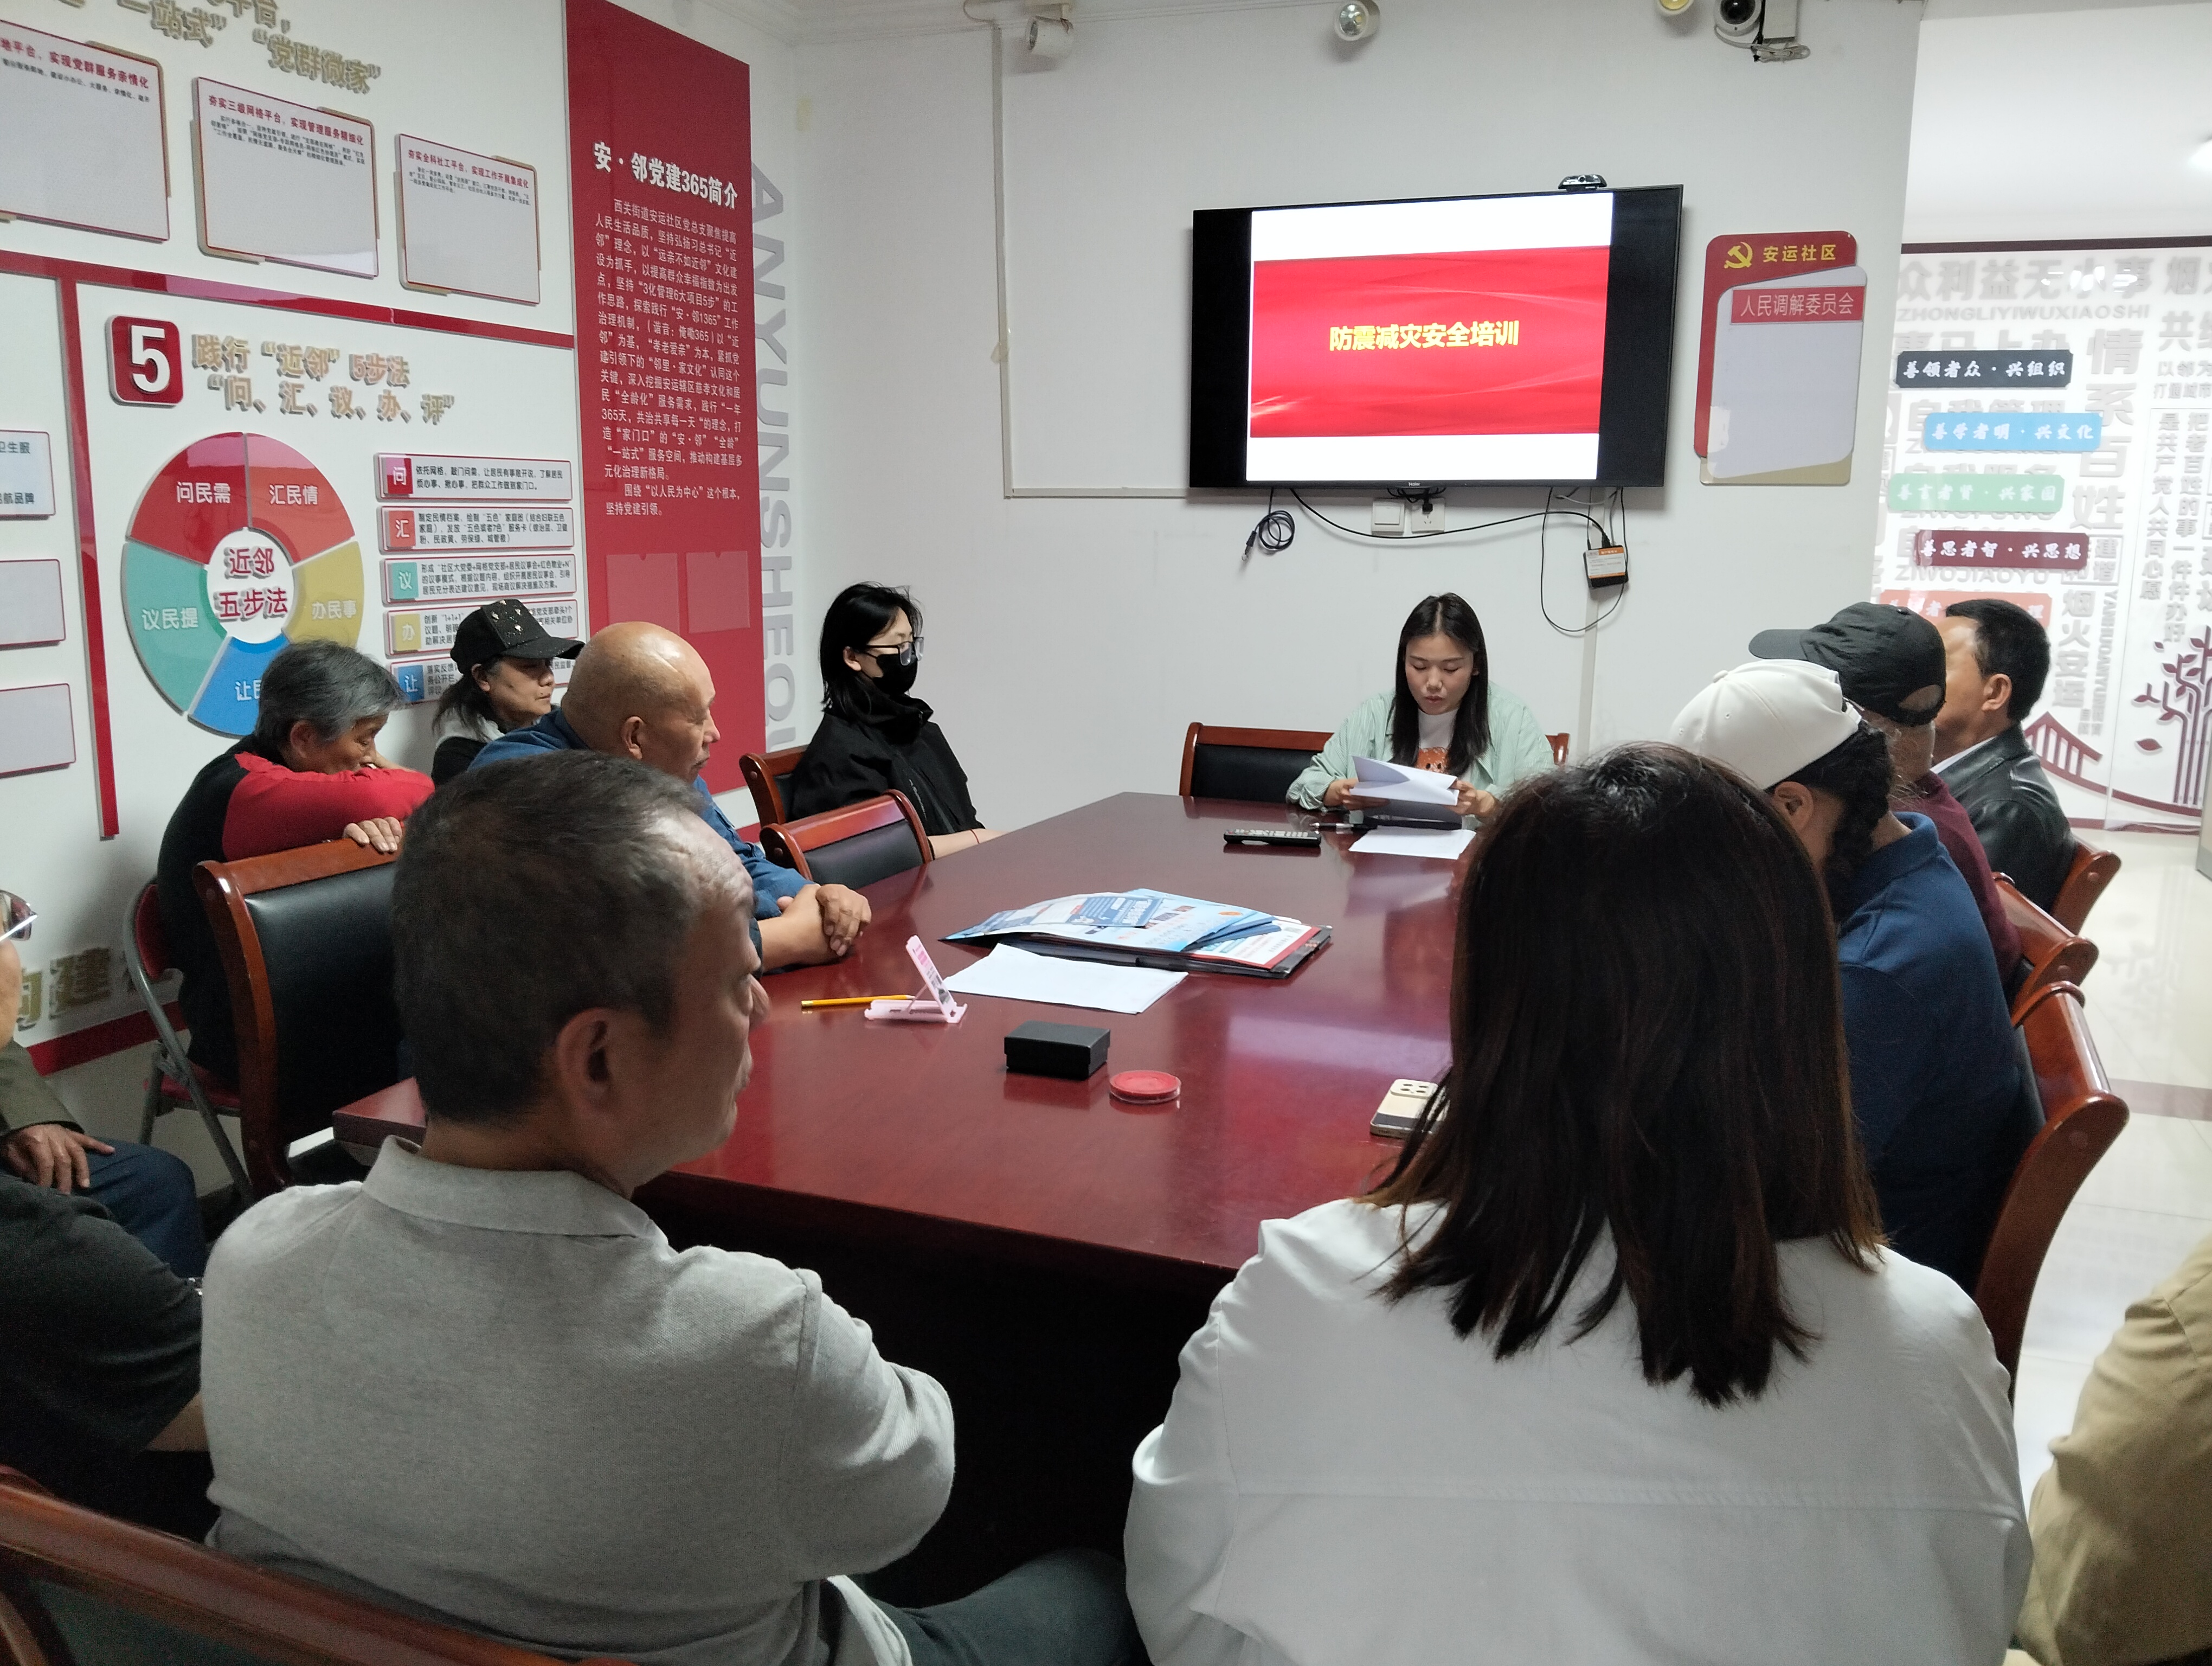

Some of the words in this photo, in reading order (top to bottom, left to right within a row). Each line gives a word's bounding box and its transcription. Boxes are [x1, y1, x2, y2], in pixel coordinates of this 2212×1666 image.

[594, 142, 738, 209] 安·邻党建365简介
[614, 198, 737, 244] 西关街道安运社区党总支聚焦提高
[1762, 245, 1837, 263] 安运社区
[596, 253, 738, 296] 设为抓手，以提高群众幸福指数为出发
[1740, 292, 1854, 317] 人民调解委员会
[1896, 304, 2150, 322] ZHONGLIYIWUXIAOSHI
[1329, 320, 1520, 351] 防震减灾安全培训
[131, 325, 171, 393] 5
[192, 334, 411, 388] 践行“近邻”5步法
[1902, 360, 2066, 379] 善领者众·兴组织
[600, 369, 741, 399] 关键，深入挖掘安运辖区慈孝文化和居
[1932, 422, 2094, 440] 善学者明·兴文化
[2070, 329, 2144, 530] 情系百姓
[393, 466, 407, 486] 问
[605, 464, 669, 480] 元化治理新格局。
[0, 492, 35, 504] 航品牌
[176, 482, 231, 504] 问民需
[269, 484, 319, 507] 汇民情
[606, 502, 663, 516] 坚持党建引领。
[2140, 413, 2180, 600] 是共产党人共同心愿
[395, 519, 410, 539] 汇
[1920, 539, 2081, 560] 善思者智·兴思想
[228, 547, 275, 579] 近邻
[398, 571, 413, 590] 议
[217, 587, 288, 622] 五步法
[311, 599, 357, 621] 办民事
[142, 607, 199, 632] 议民提
[401, 623, 416, 642] 办
[404, 674, 419, 693] 让
